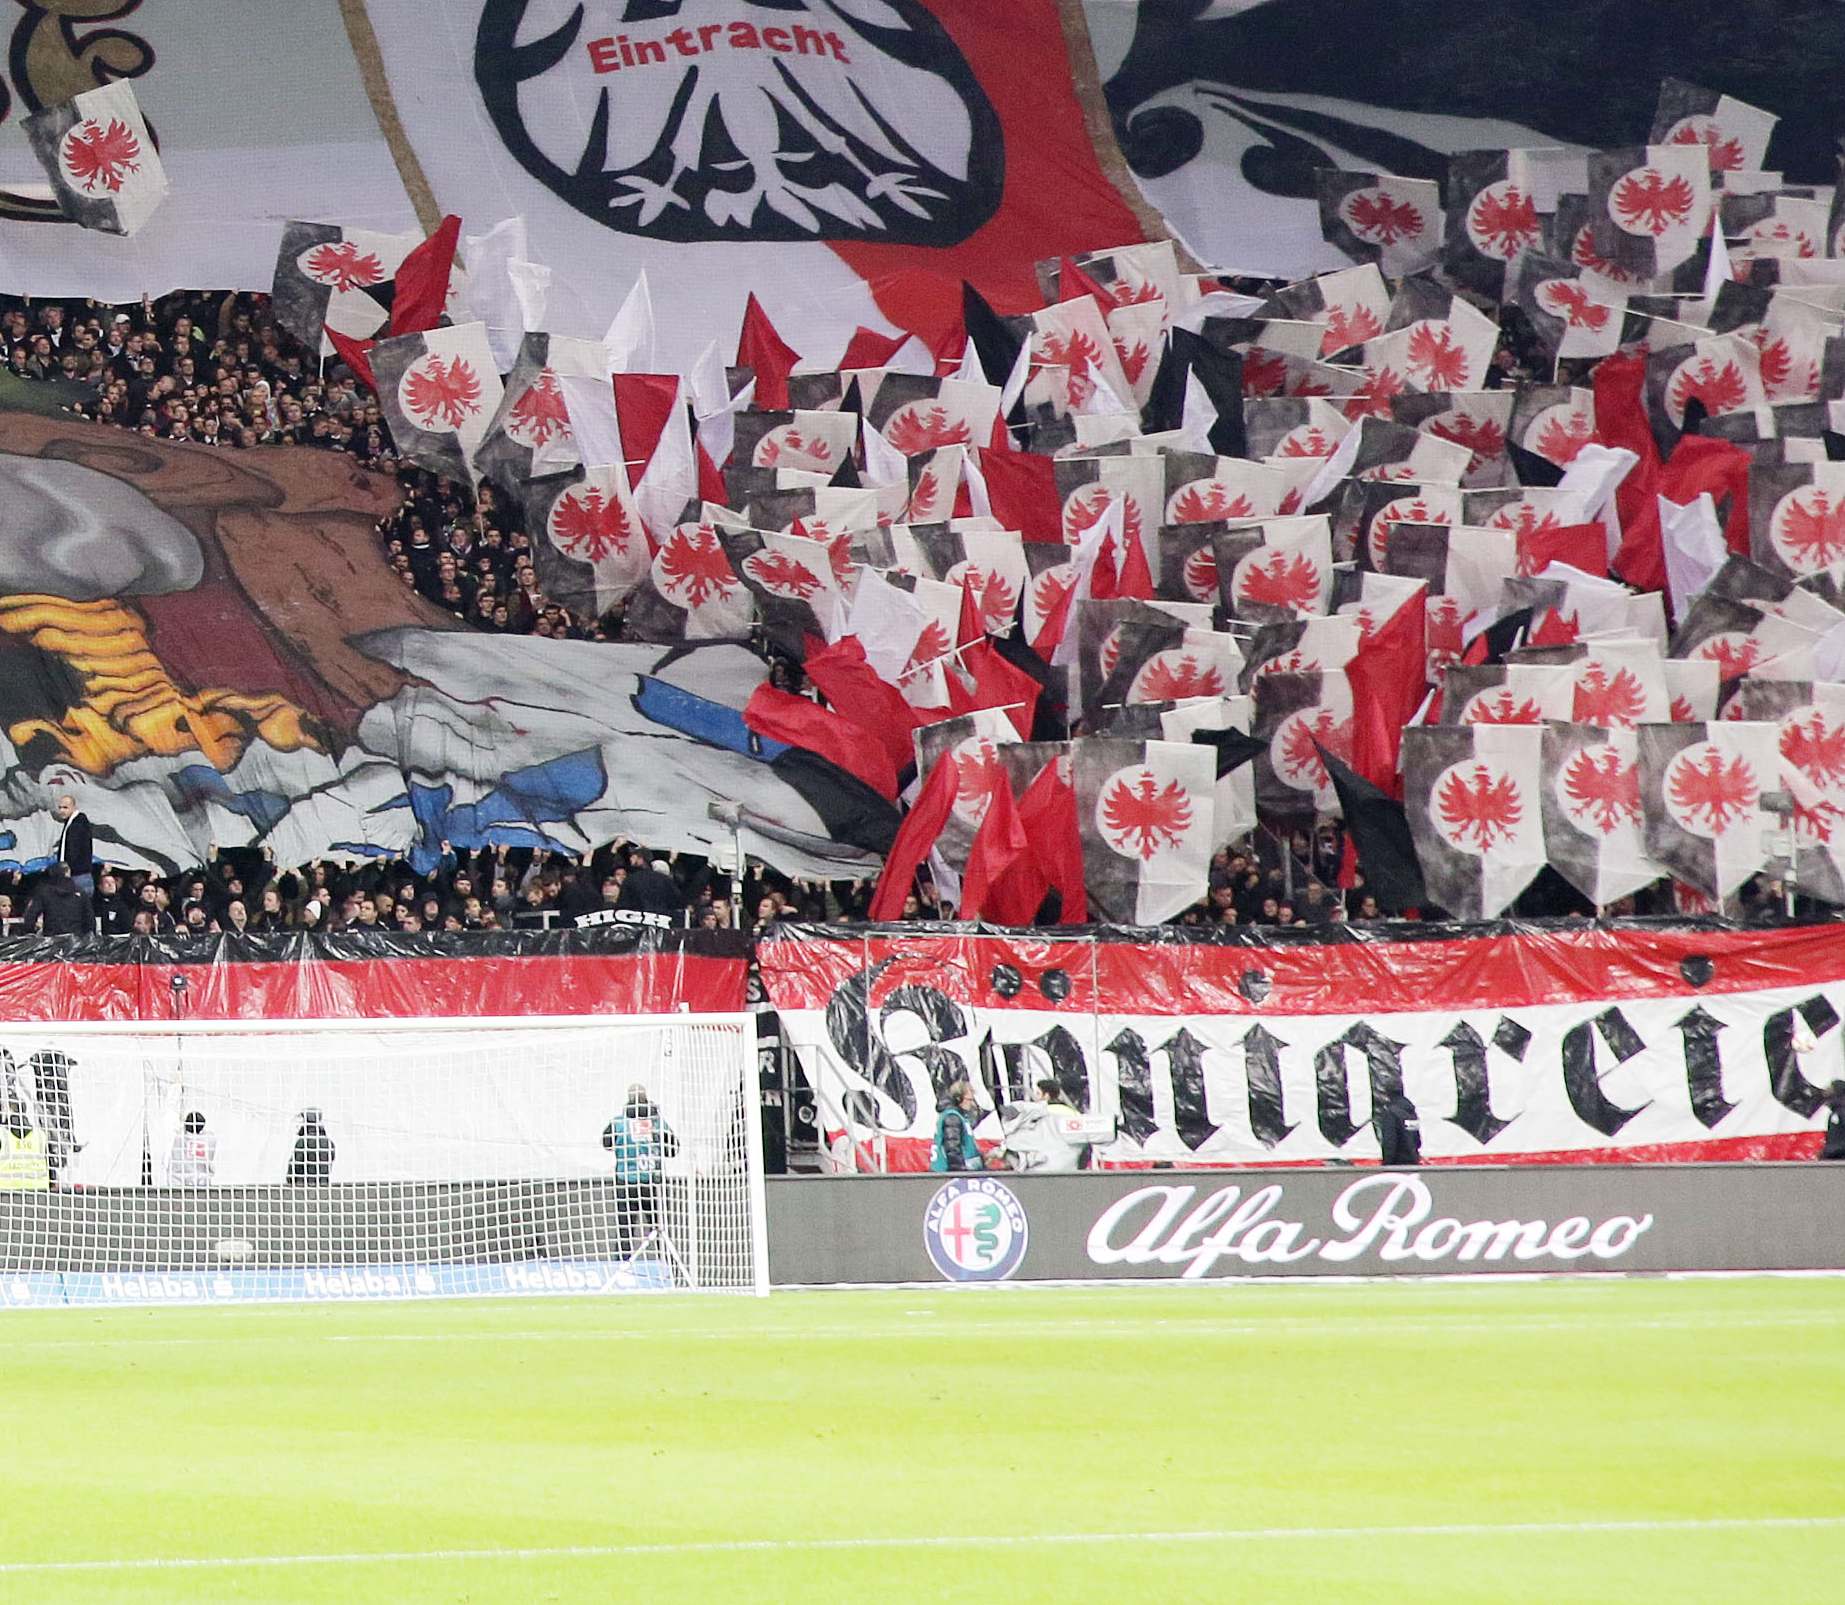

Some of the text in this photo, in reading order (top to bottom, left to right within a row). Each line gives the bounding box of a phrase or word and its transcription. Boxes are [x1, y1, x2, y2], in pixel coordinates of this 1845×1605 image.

[587, 21, 851, 74] Eintracht
[574, 909, 672, 929] HIGH
[825, 953, 1845, 1160] Königreic
[927, 1179, 1024, 1233] ALFA ROMEO
[1086, 1171, 1654, 1278] Alfa Romeo
[101, 1274, 197, 1298] Helaba
[303, 1271, 400, 1296] Helaba
[505, 1264, 600, 1290] Helaba
